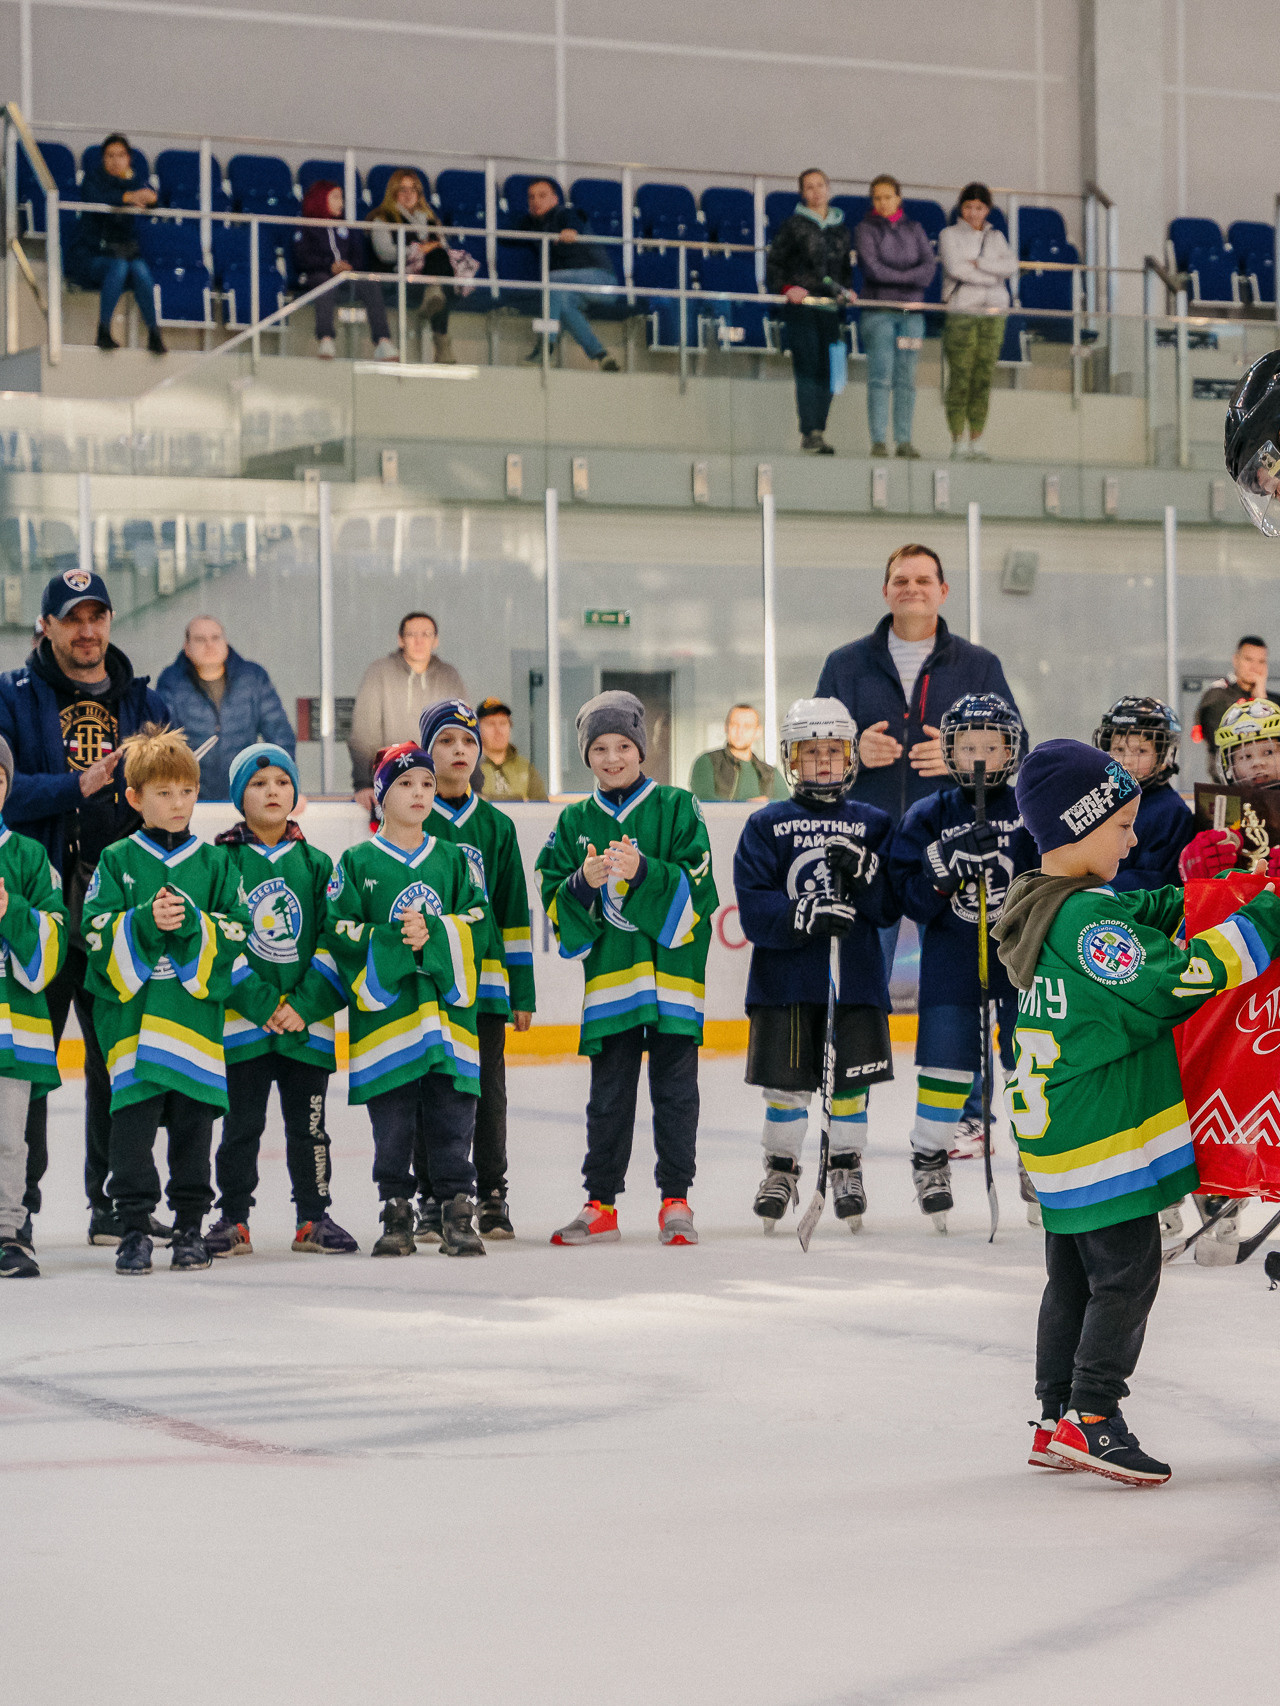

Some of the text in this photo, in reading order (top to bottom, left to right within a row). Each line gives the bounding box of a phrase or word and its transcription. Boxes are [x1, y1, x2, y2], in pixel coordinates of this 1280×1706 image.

[964, 710, 992, 718] CCM
[1071, 794, 1115, 837] HUNT
[773, 818, 867, 838] КУРОРТНЫЙ
[793, 833, 825, 848] РАЙ
[1100, 919, 1129, 930] СПОРТА
[1077, 954, 1118, 986] ФИЗИЧЕСКОЙ
[1118, 972, 1139, 985] ЦЕНТР
[845, 1059, 889, 1079] CCM
